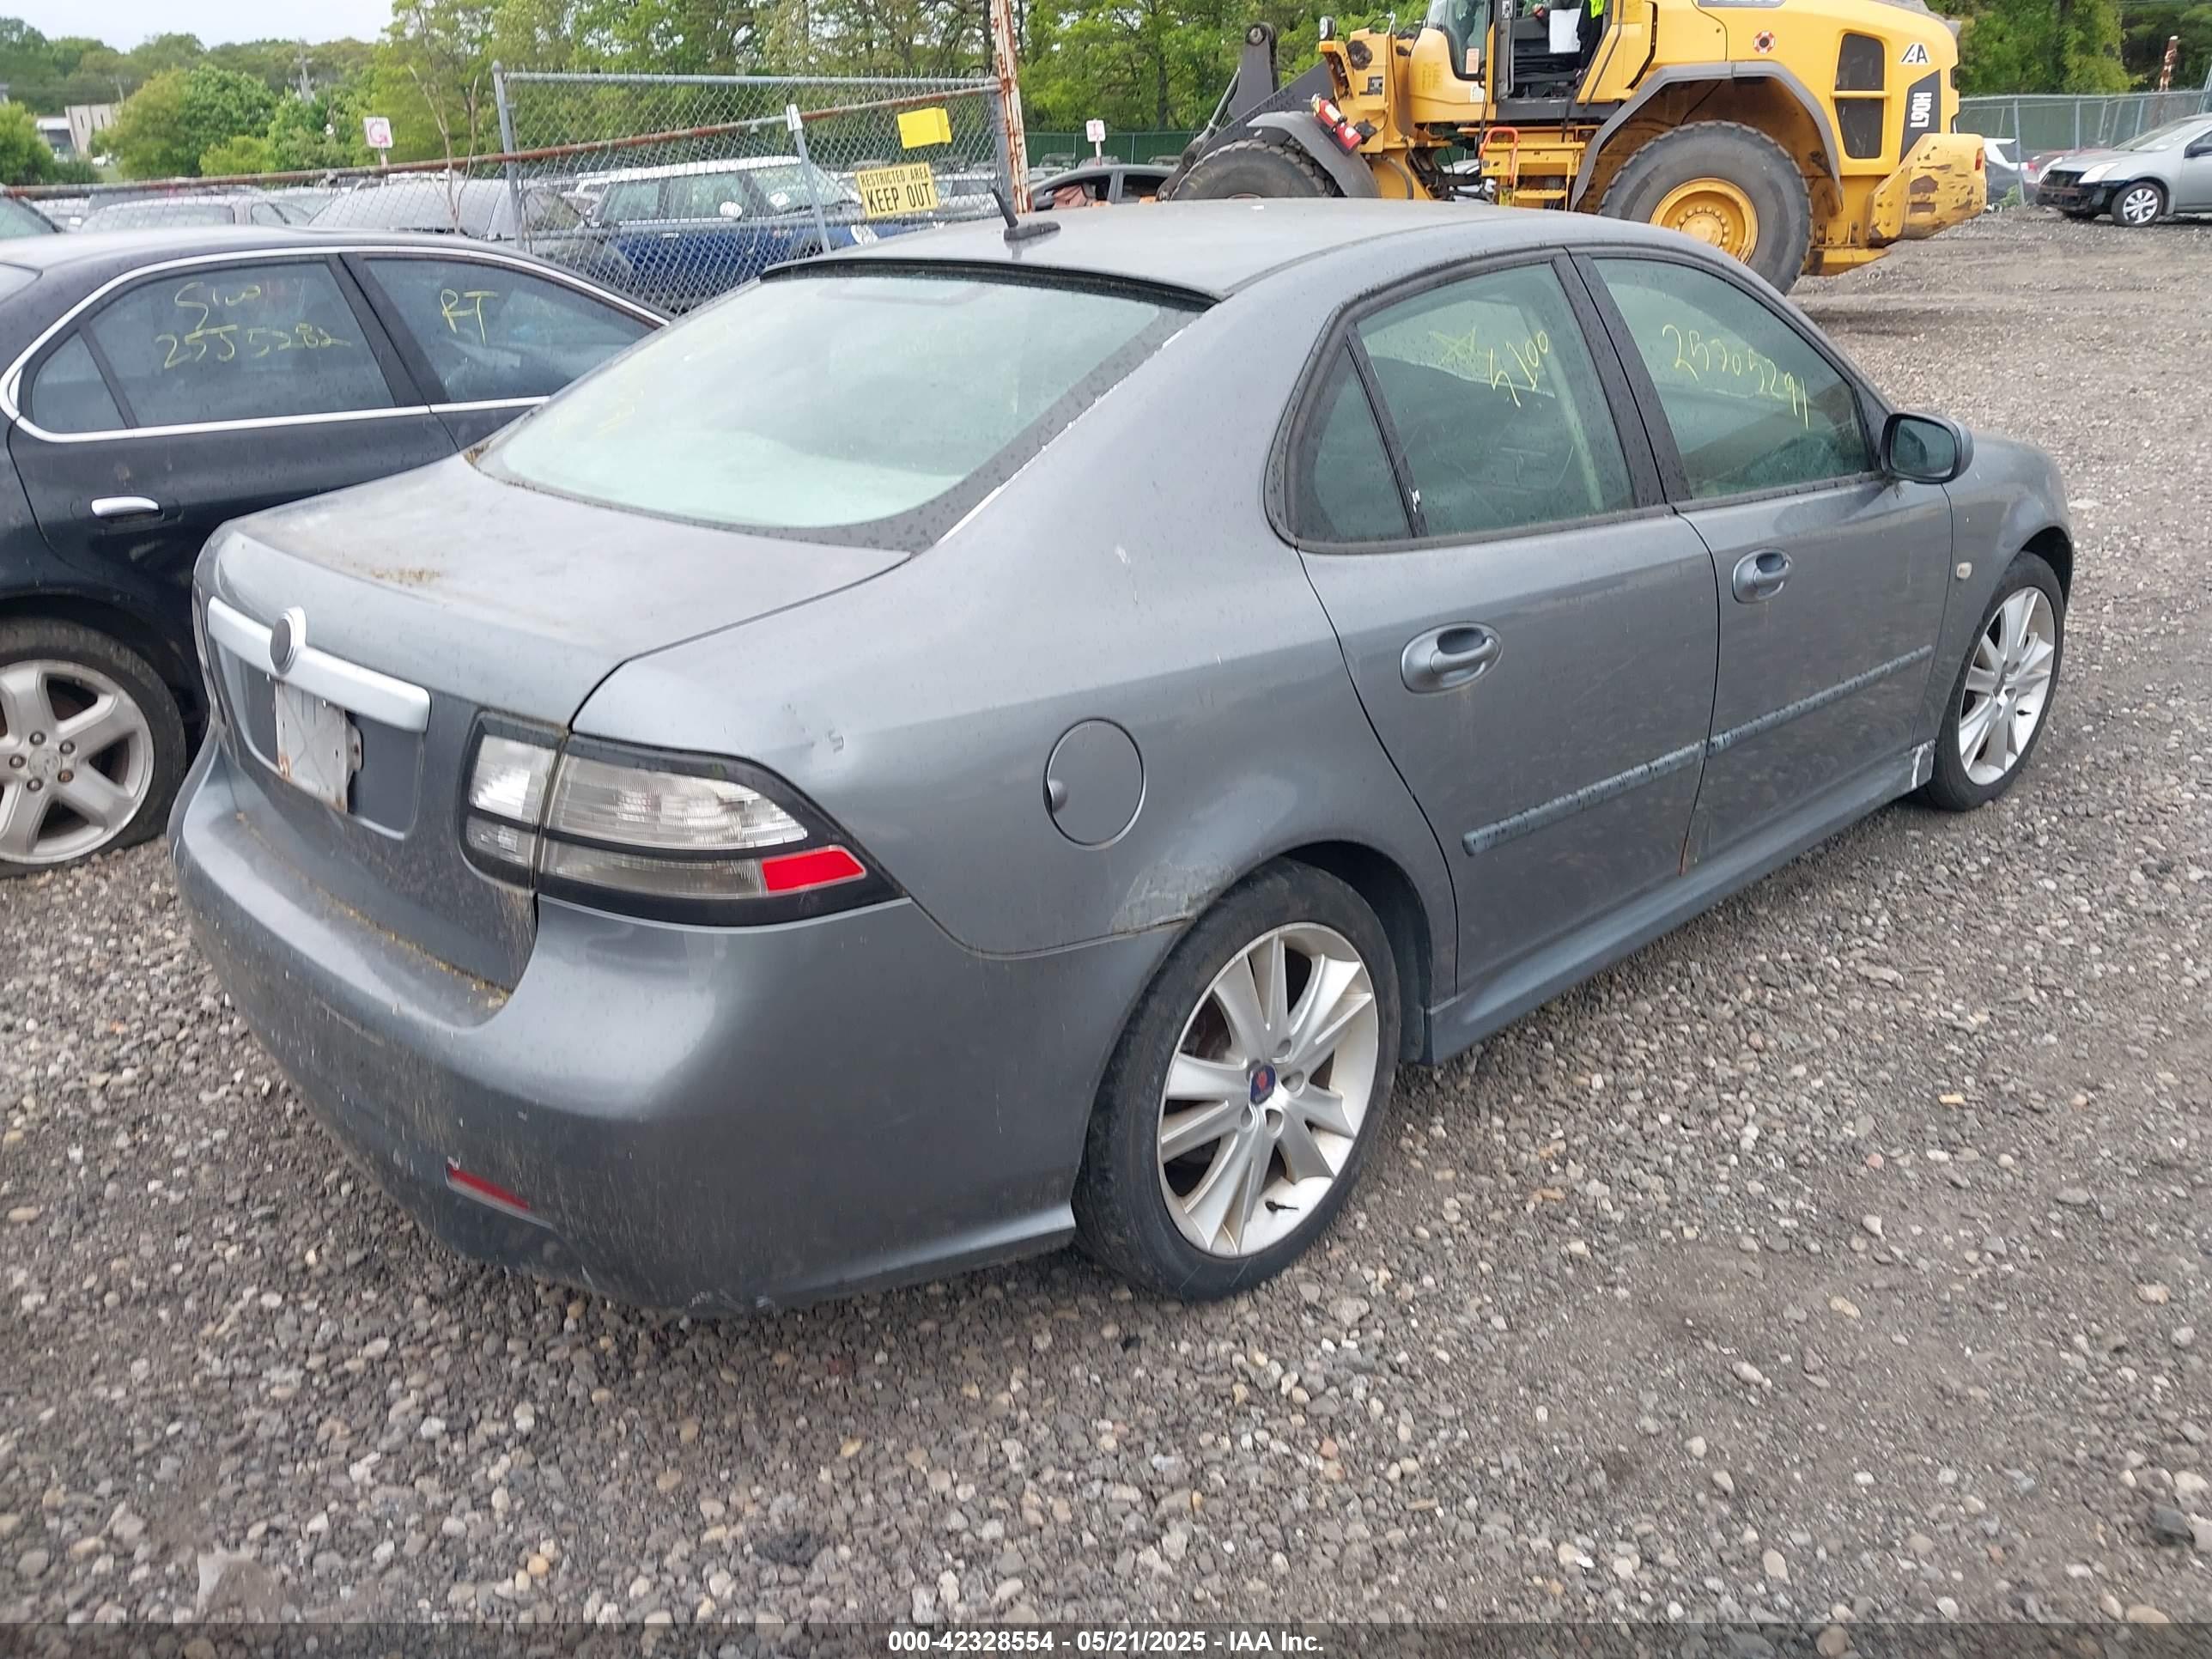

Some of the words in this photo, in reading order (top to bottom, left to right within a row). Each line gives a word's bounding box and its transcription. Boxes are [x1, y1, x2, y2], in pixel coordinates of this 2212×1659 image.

[1909, 92, 1933, 129] L90H
[860, 169, 906, 188] RESTRICTED
[910, 166, 929, 182] AREA
[866, 186, 900, 214] KEEP
[907, 183, 932, 208] OUT
